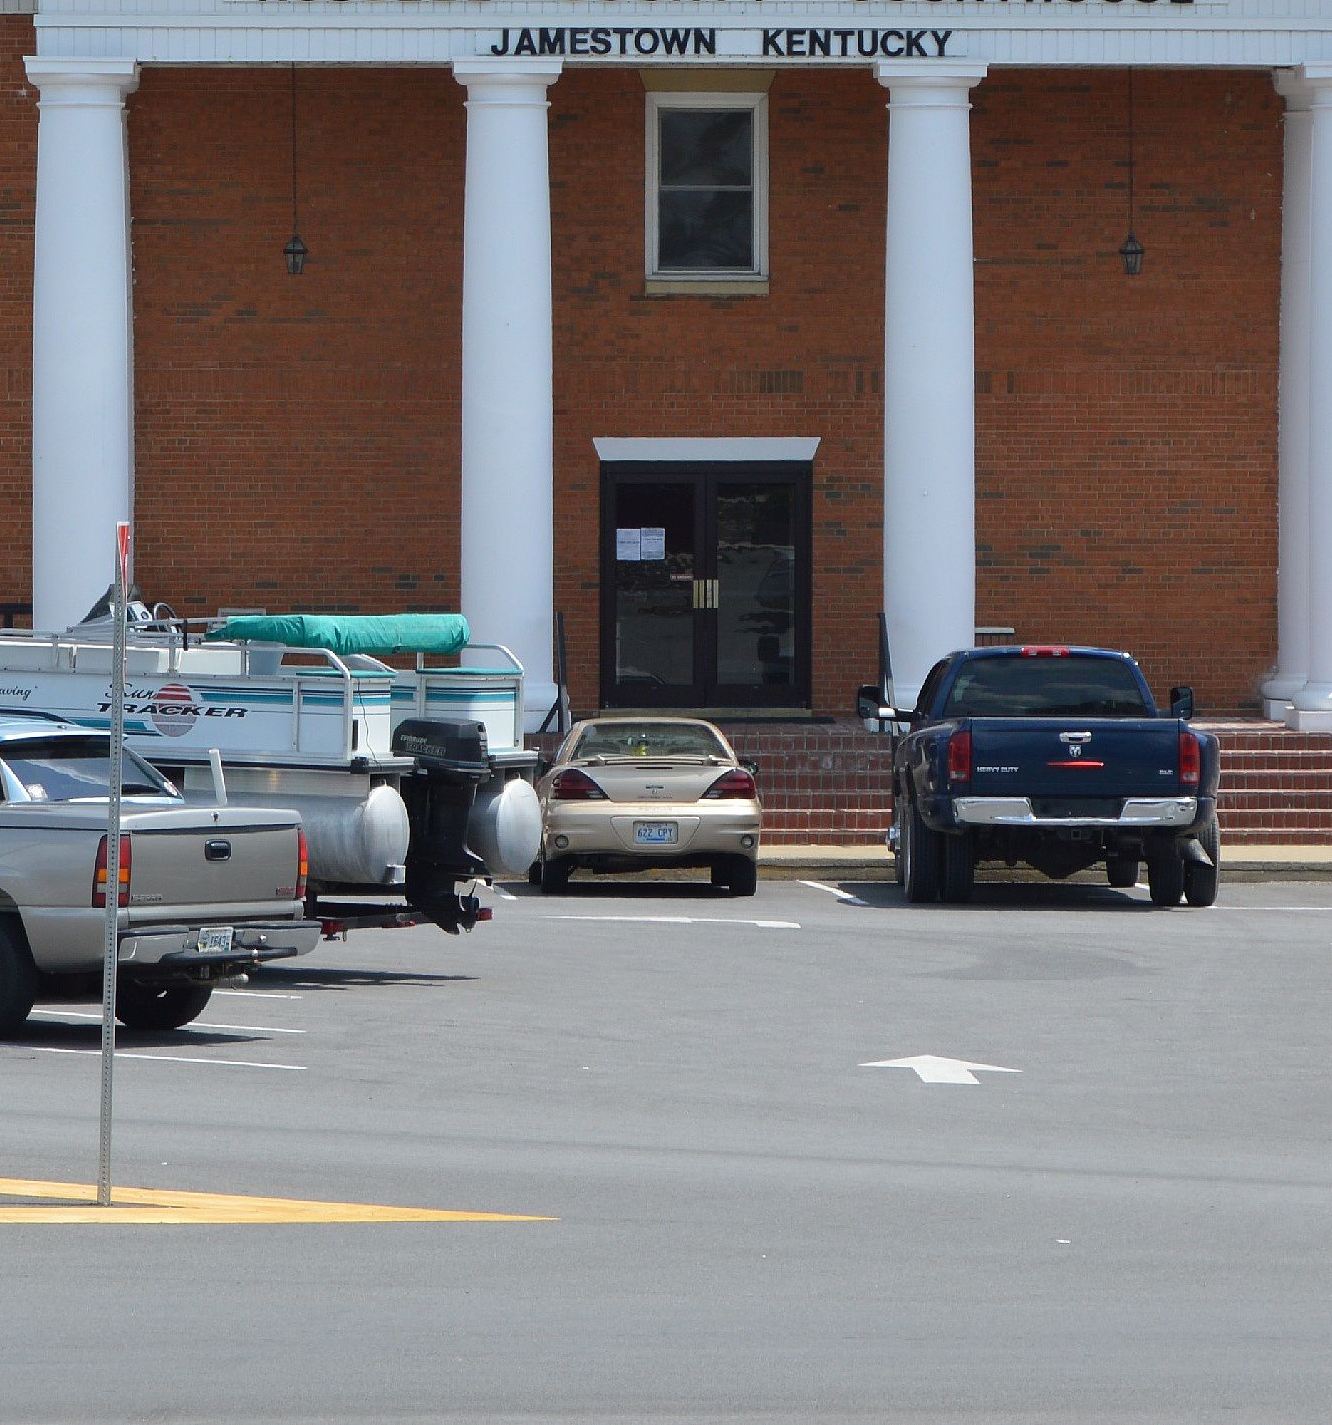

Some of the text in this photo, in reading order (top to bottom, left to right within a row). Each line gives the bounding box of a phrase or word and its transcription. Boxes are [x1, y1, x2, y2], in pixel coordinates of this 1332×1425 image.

[491, 28, 953, 57] JAMESTOWN KENTUCKY
[97, 702, 249, 718] TRACKER
